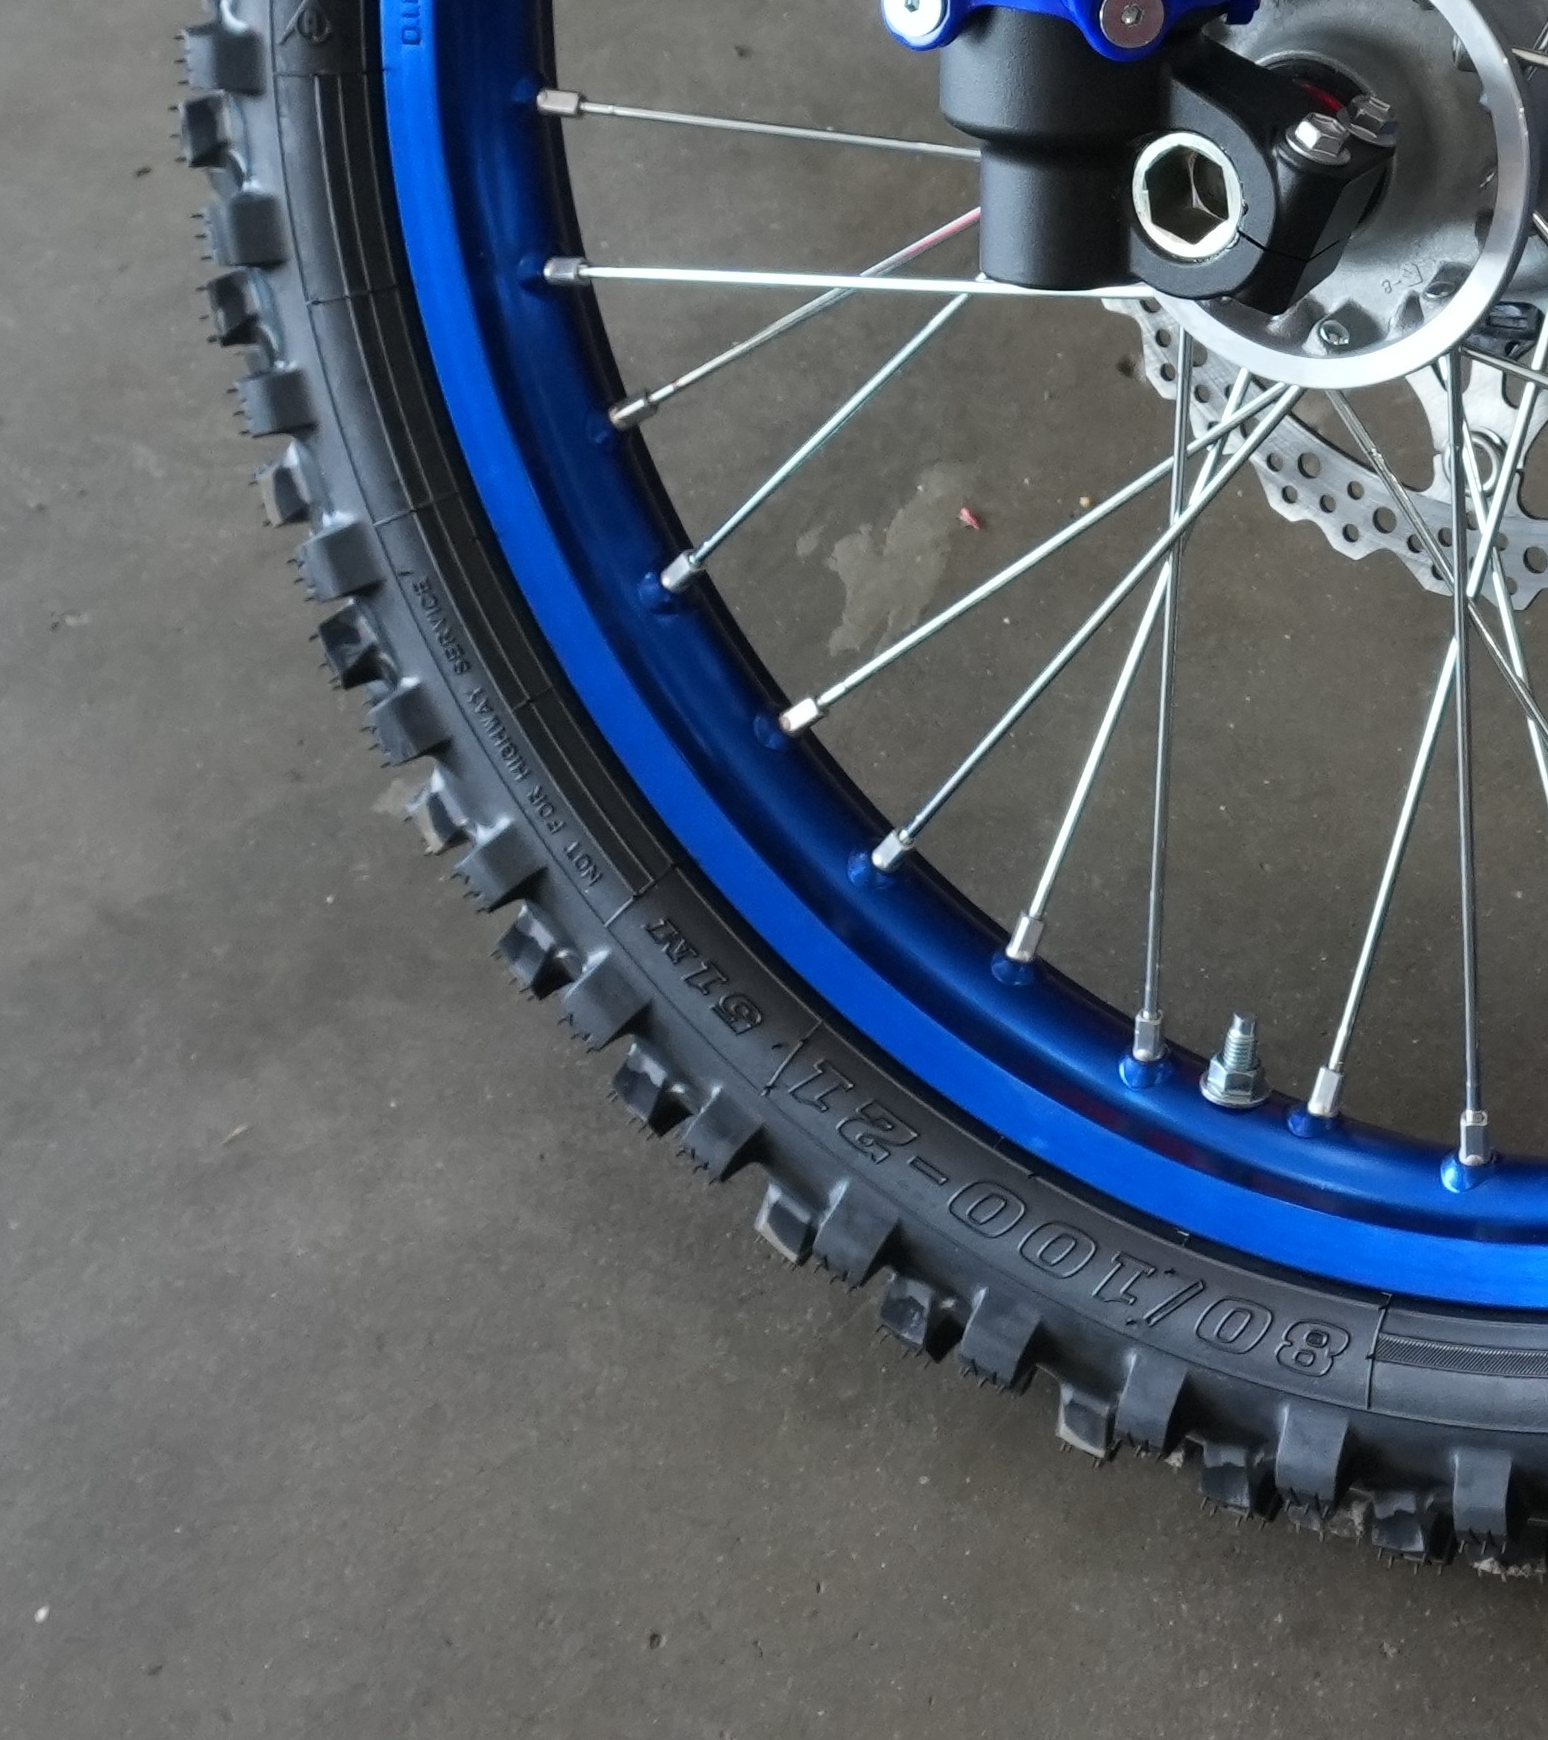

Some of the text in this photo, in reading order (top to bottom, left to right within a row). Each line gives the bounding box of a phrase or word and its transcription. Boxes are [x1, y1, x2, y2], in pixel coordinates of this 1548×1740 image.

[413, 575, 603, 888] NOT FOR HIGHWAY SERVICE
[645, 916, 764, 1038] 51M
[783, 1058, 1351, 1378] 80/100-21
